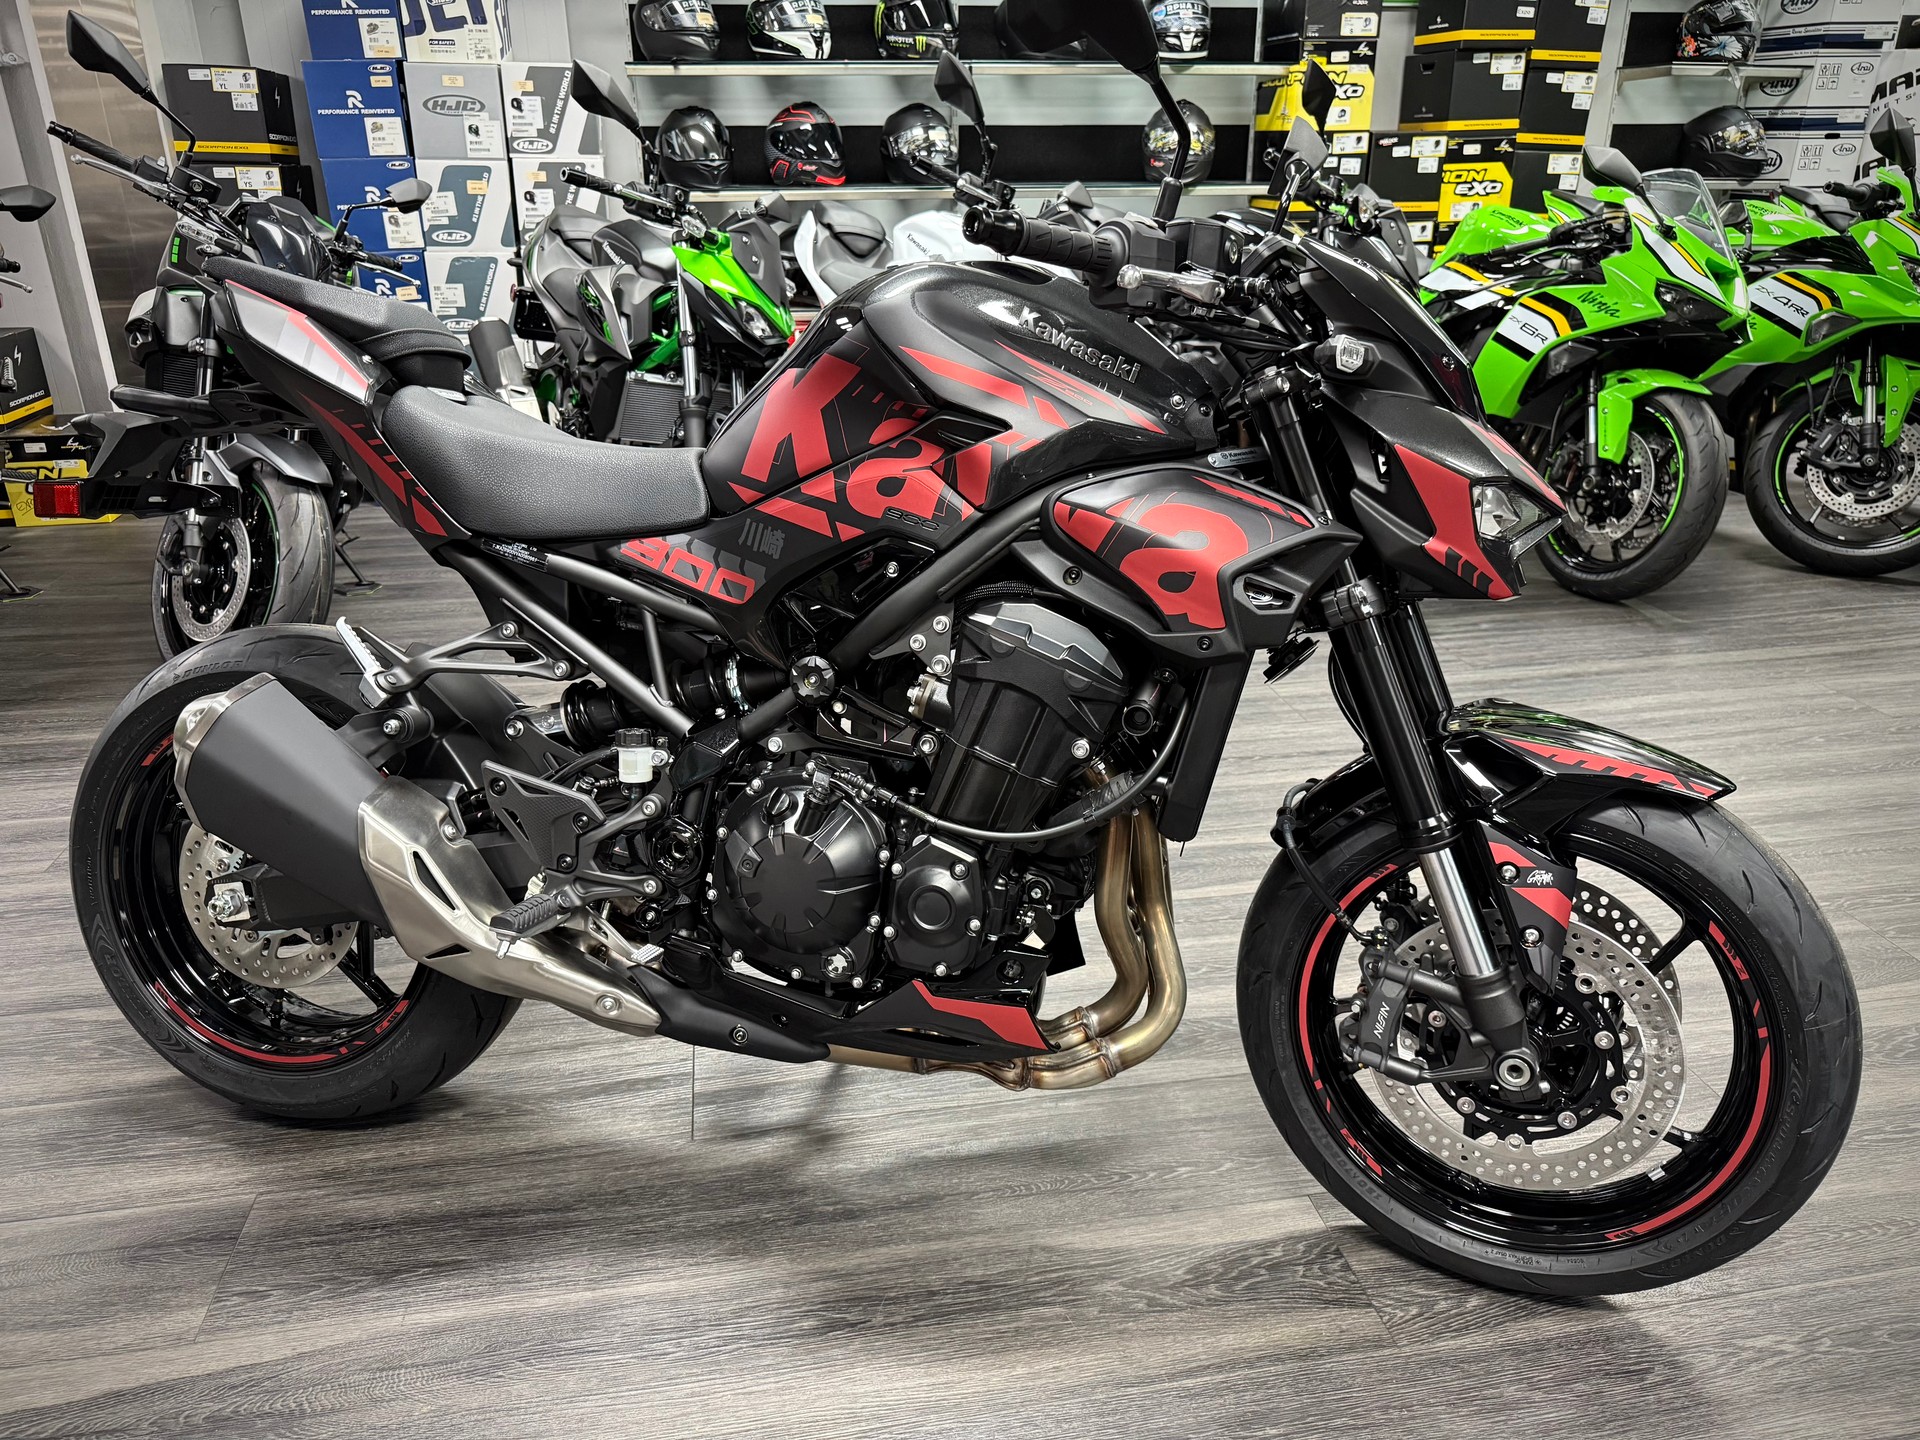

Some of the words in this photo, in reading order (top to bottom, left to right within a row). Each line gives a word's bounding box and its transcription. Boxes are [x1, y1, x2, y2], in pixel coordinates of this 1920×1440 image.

[558, 70, 571, 99] WORLD
[431, 99, 478, 112] HJC
[554, 99, 564, 114] THE
[518, 141, 549, 150] HJC
[438, 232, 466, 241] HJC
[486, 262, 496, 285] WORLD
[482, 284, 491, 298] THE
[1577, 290, 1620, 318] Ninja
[446, 320, 474, 329] HJC
[1018, 305, 1142, 384] Kawasaki
[885, 508, 942, 533] 900
[738, 518, 786, 560] 川崎
[620, 537, 756, 605] 900
[182, 660, 244, 679] DUNLOP
[1373, 1001, 1390, 1040] NISSIN
